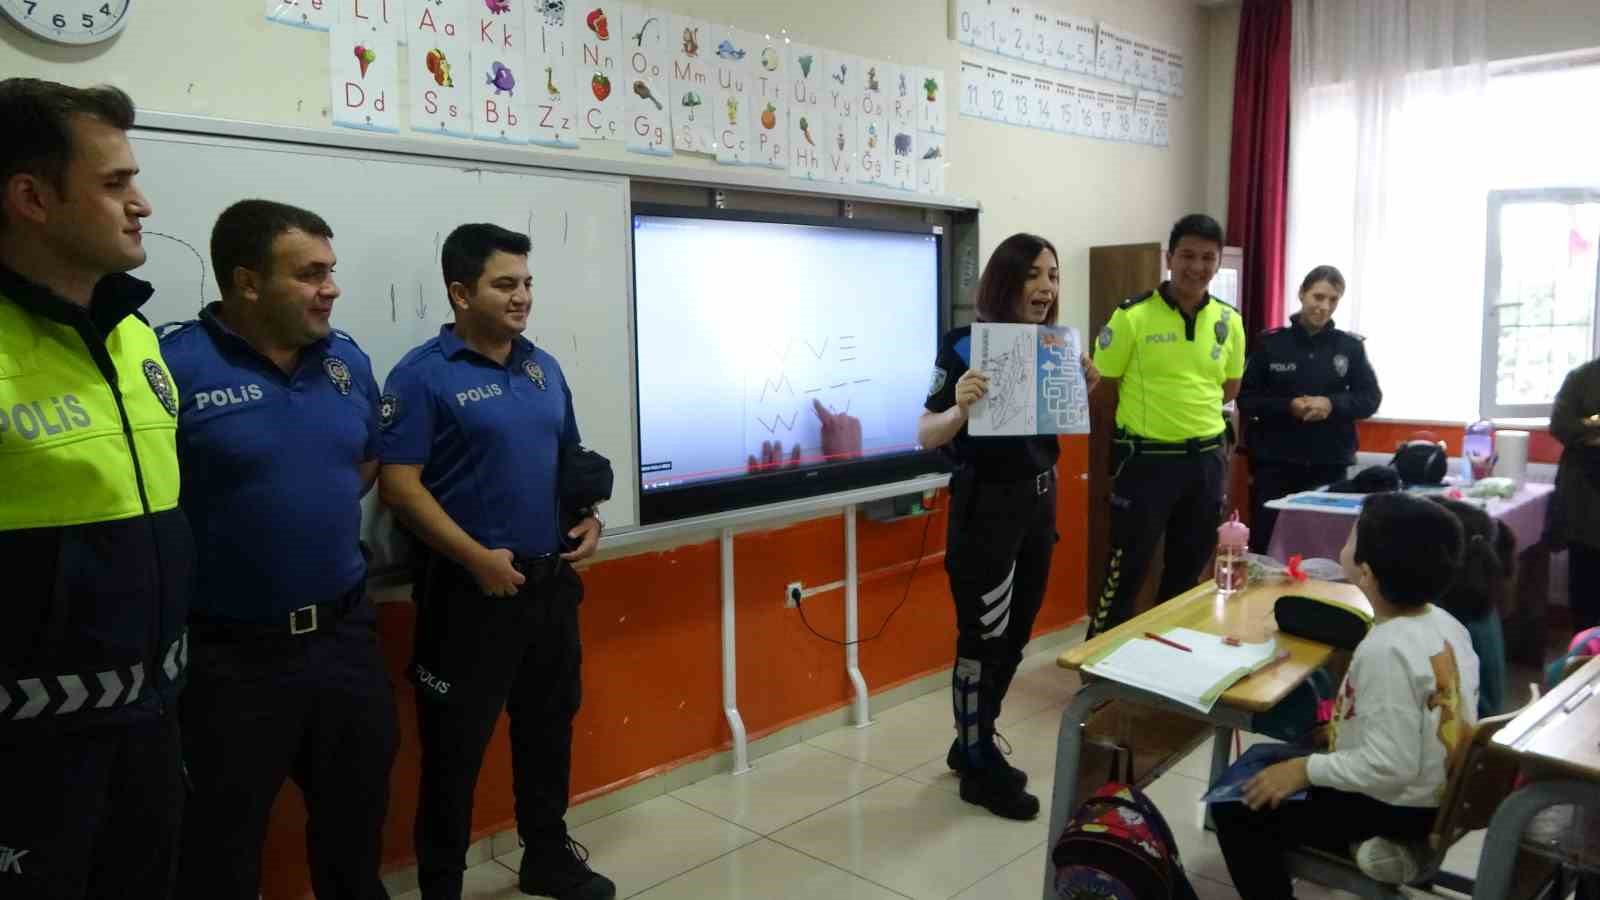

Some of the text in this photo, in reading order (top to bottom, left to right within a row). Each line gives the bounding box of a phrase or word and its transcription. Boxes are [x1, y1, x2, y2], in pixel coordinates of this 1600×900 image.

[23, 0, 37, 15] 7
[99, 2, 112, 16] 4
[52, 14, 66, 28] 6
[81, 14, 94, 28] 5
[968, 84, 979, 107] 11
[991, 89, 1005, 111] 12
[1015, 95, 1028, 115] 13
[1038, 98, 1050, 118] 14
